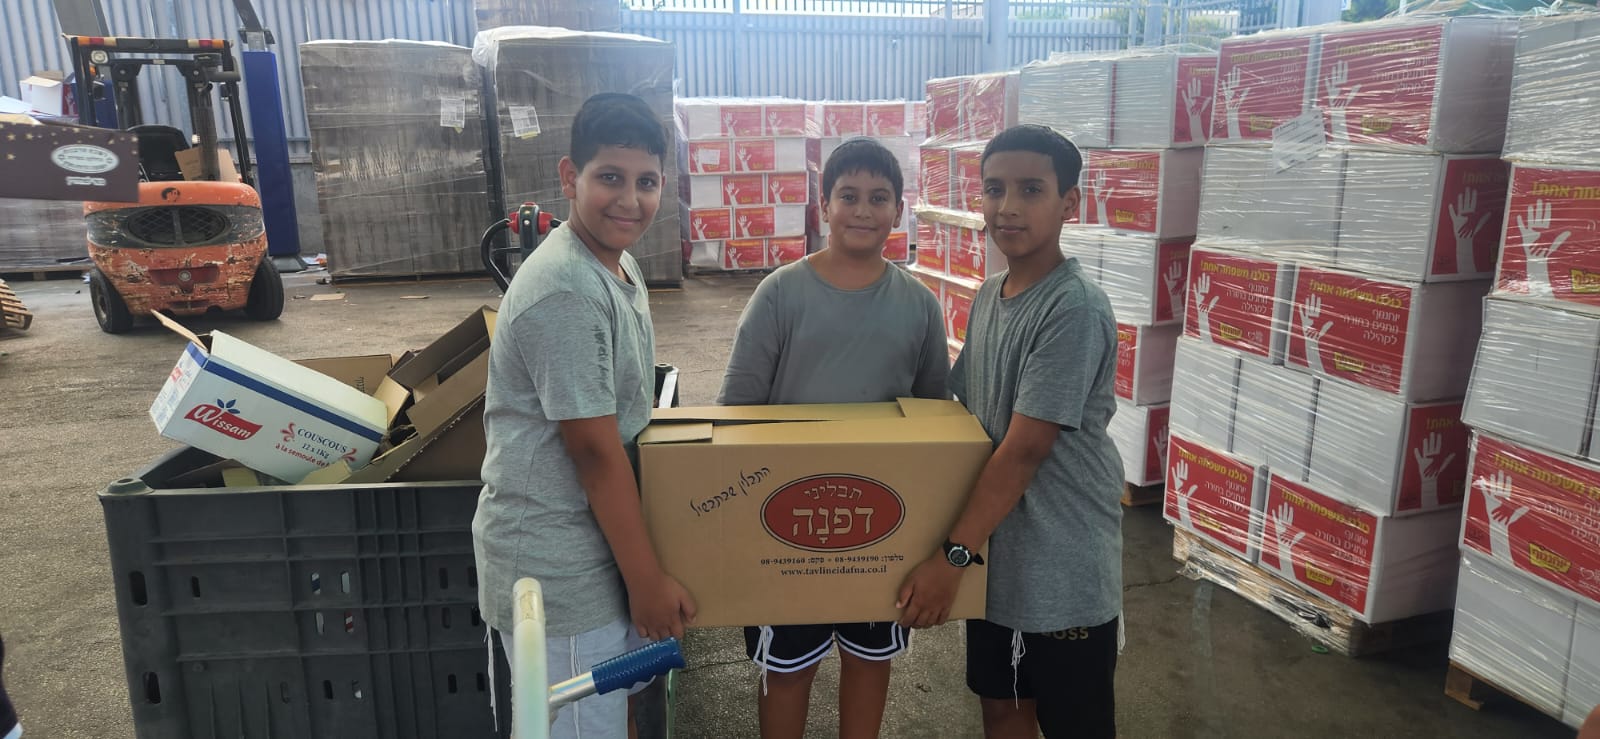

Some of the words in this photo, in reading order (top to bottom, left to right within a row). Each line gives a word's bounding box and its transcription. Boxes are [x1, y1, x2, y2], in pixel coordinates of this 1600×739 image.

[193, 406, 252, 439] Wissam
[297, 428, 348, 453] COUSCOUS
[288, 449, 316, 464] semoule
[804, 481, 862, 501] תבליני
[780, 565, 887, 576] www.tavlineidafna.co.il
[1041, 627, 1089, 641] OSS
